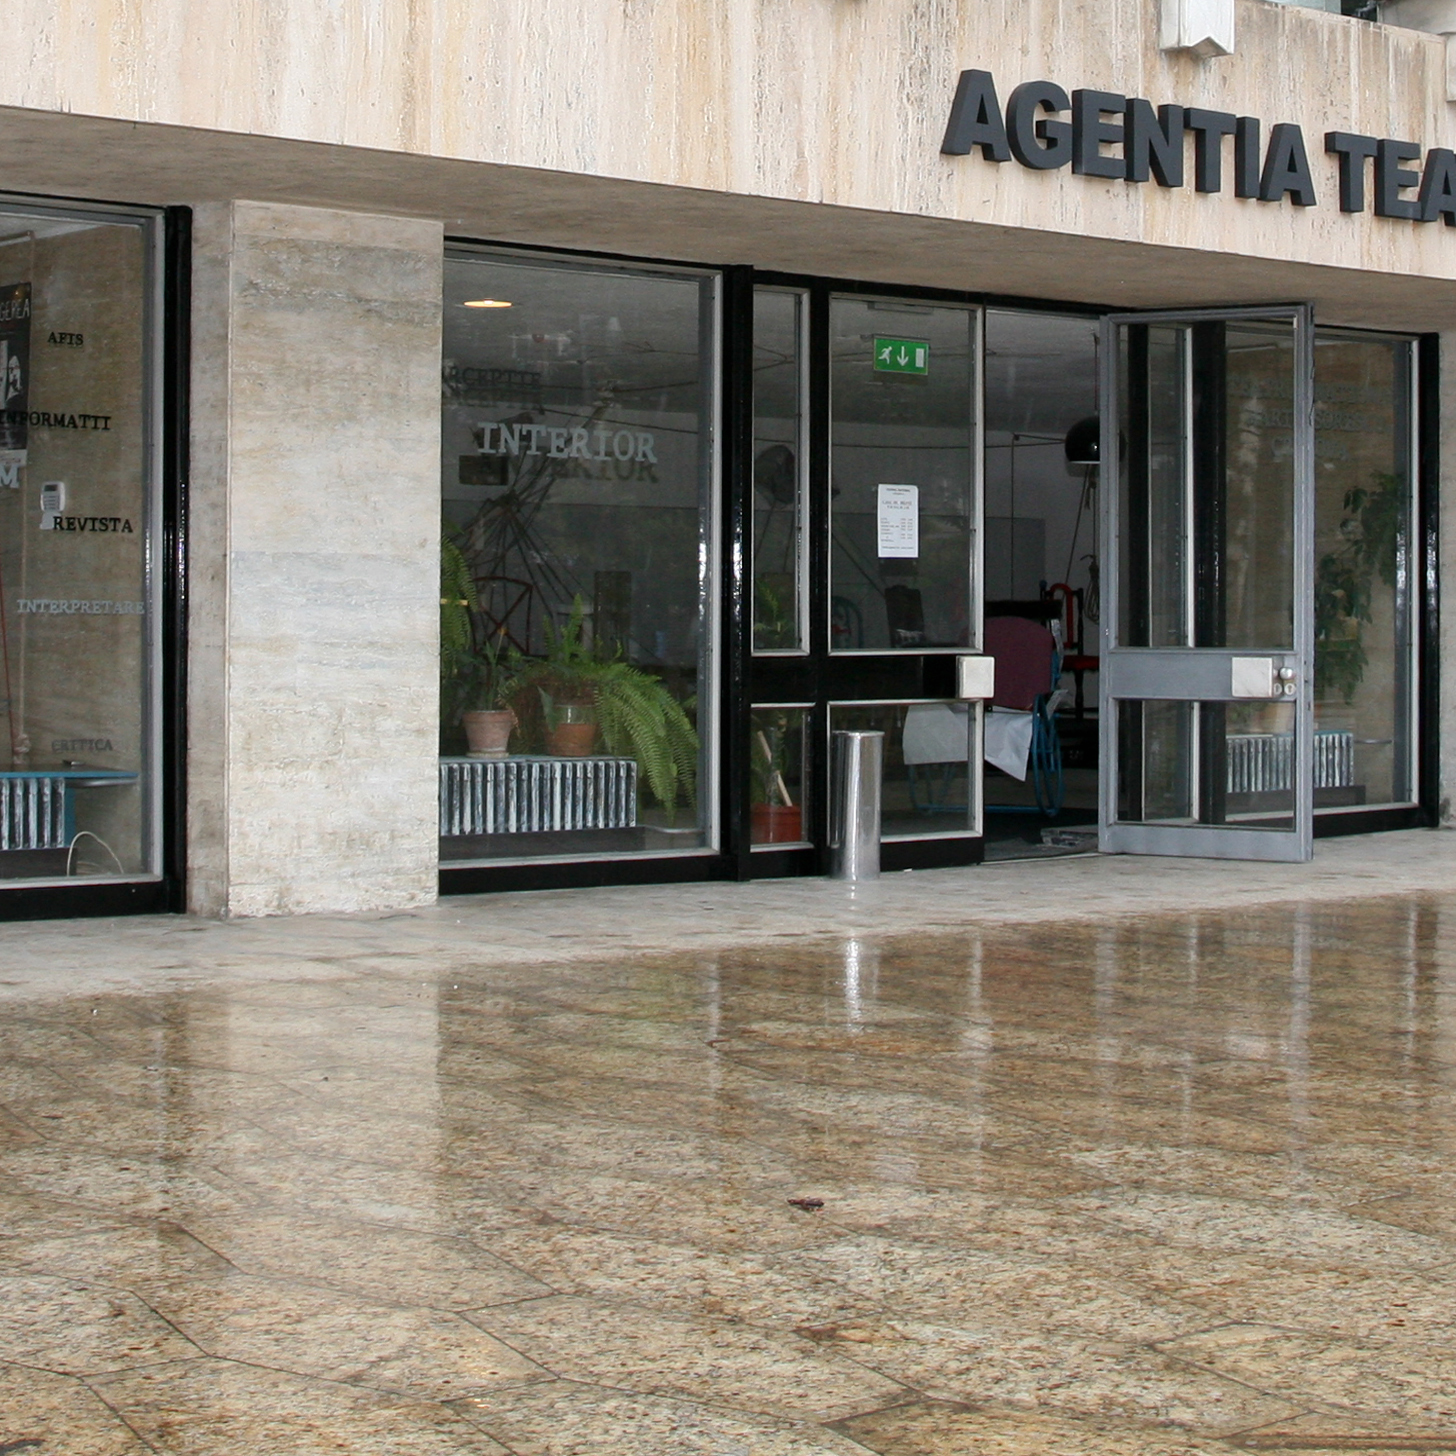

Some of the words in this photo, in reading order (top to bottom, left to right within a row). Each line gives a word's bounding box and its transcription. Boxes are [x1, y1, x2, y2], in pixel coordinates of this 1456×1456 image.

[940, 69, 1316, 207] AGENTIA
[48, 332, 84, 345] AFIS
[477, 421, 658, 464] INTERIOR
[53, 516, 134, 534] REVISTA
[17, 599, 145, 616] INTERPRETARE
